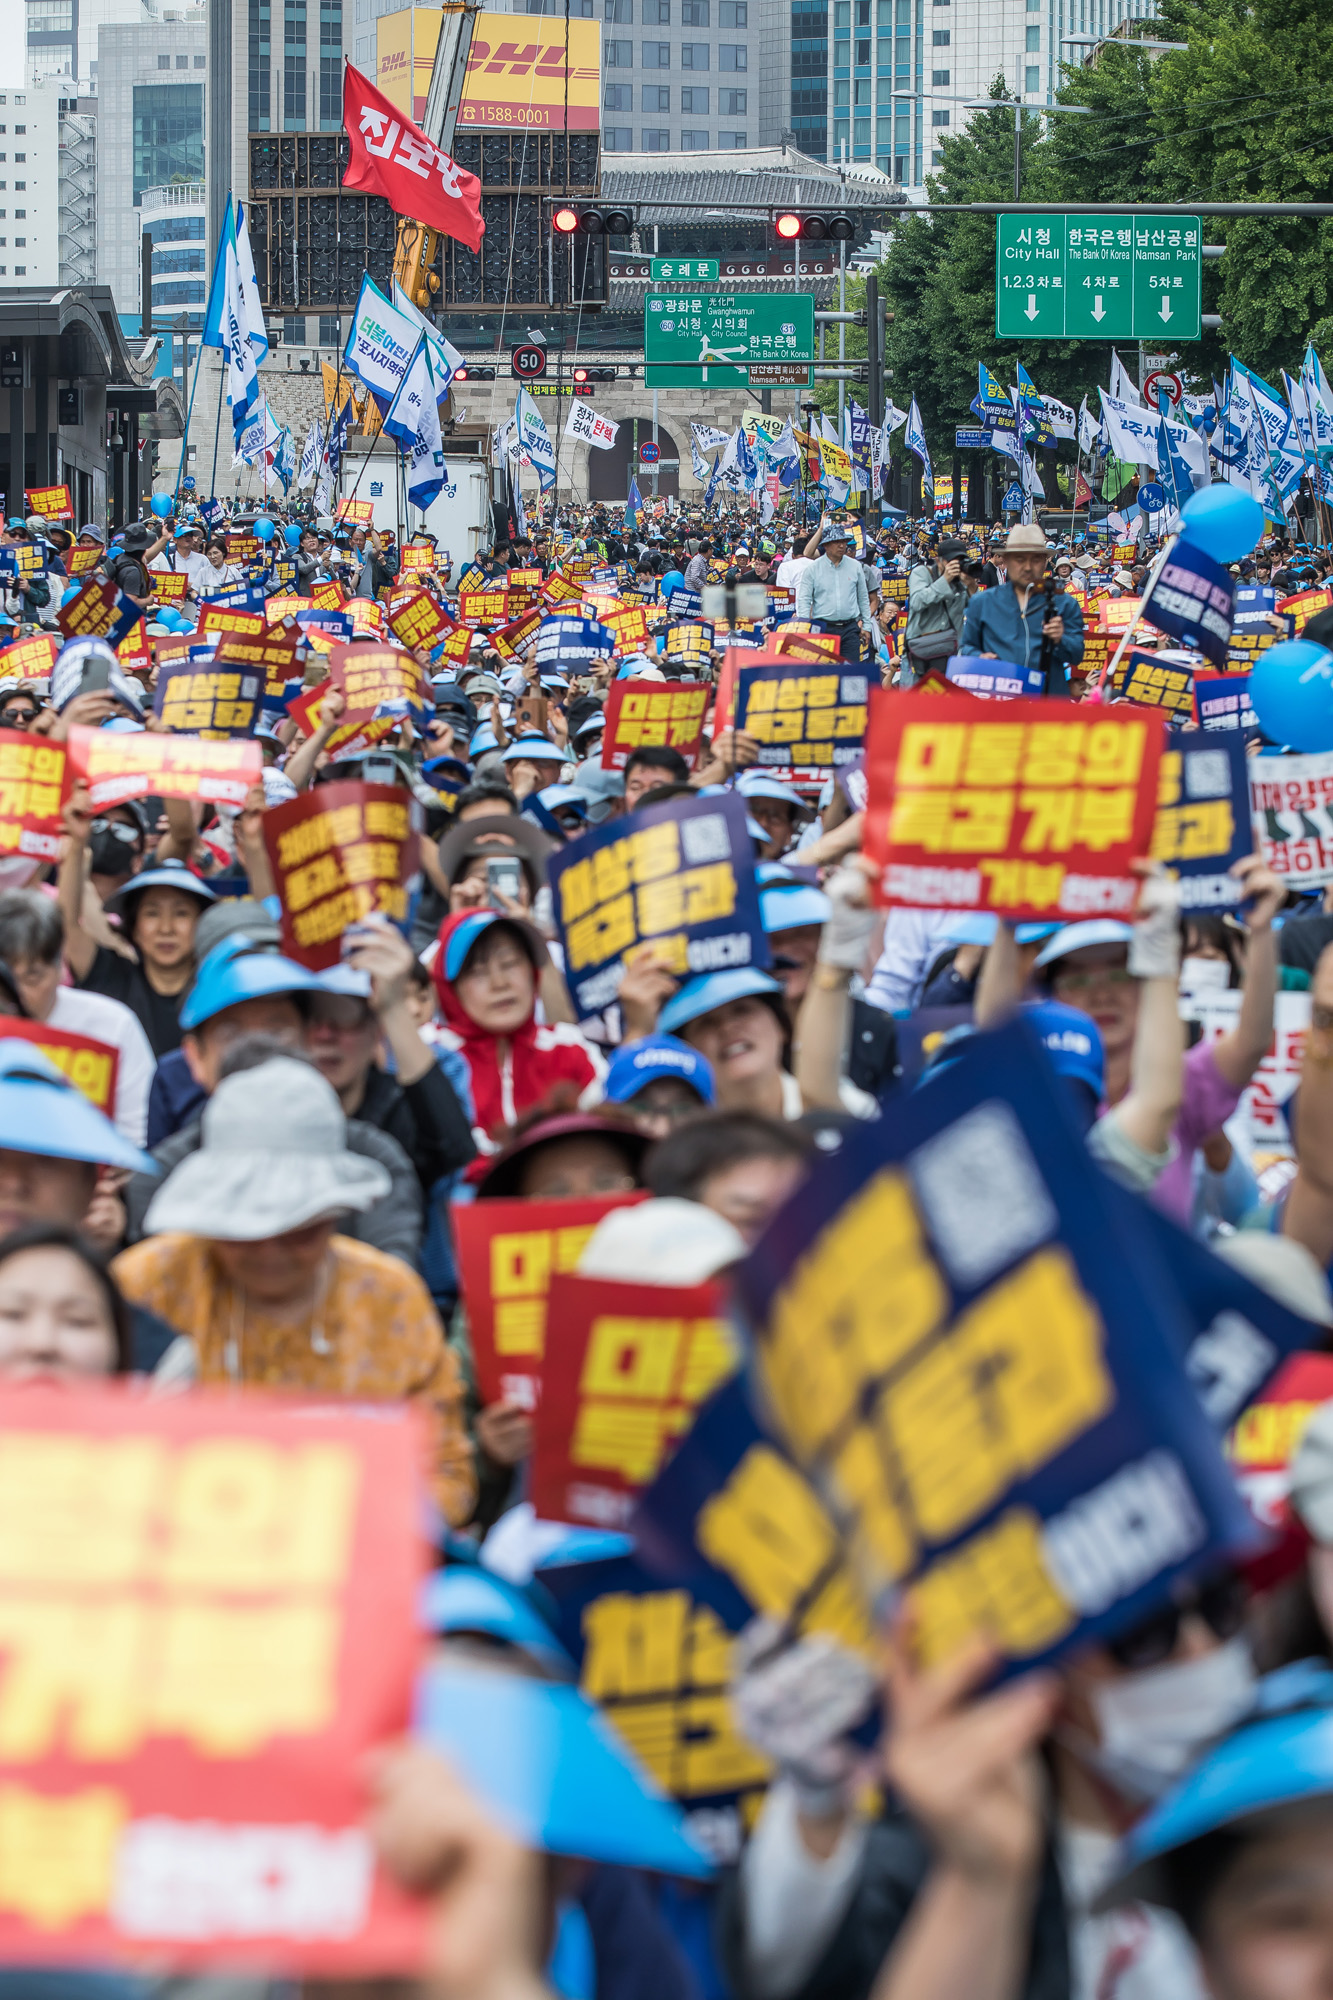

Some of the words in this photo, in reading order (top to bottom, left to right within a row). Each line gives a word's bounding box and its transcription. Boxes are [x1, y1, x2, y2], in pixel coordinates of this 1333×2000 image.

[381, 51, 406, 73] DHL
[479, 106, 549, 124] 1588-0001
[1016, 227, 1051, 245] 시청
[1068, 228, 1132, 247] 한국은행
[1135, 229, 1197, 247] 남산공원
[1005, 247, 1032, 262] City
[1035, 248, 1060, 260] Hall
[1069, 249, 1081, 259] The
[1083, 249, 1099, 260] Bank
[1101, 249, 1109, 260] Of
[1110, 249, 1130, 260] Korea
[1135, 250, 1170, 260] Namsan
[1176, 250, 1196, 261] Park
[660, 262, 710, 277] 숭례문
[651, 302, 662, 310] 50
[665, 299, 702, 313] 광화문
[708, 297, 735, 306] 光化門
[707, 307, 755, 317] Gwanghwamun
[662, 321, 673, 330] 60
[678, 317, 701, 330] 시청
[711, 317, 748, 330] 시의회
[783, 324, 793, 333] 31
[359, 315, 411, 365] 더불어민
[677, 330, 690, 338] City
[711, 330, 724, 338] City
[749, 335, 797, 348] 한국은행
[520, 354, 538, 368] 50
[749, 350, 761, 358] The
[763, 350, 779, 358] Bank
[780, 350, 789, 358] Of
[790, 350, 809, 358] Korea
[1147, 358, 1163, 367] 1.5t
[750, 376, 778, 384] Namsan
[779, 376, 795, 384] Park
[67, 394, 74, 402] 2
[575, 386, 592, 395] 단속
[577, 405, 595, 423] 정치
[593, 419, 614, 442] 탄핵
[524, 427, 553, 456] 을지역
[443, 483, 457, 498] 영
[1159, 562, 1214, 602] 대통령
[465, 594, 505, 607] 대통령의
[486, 604, 504, 615] 거부
[952, 673, 993, 690] 대통령
[995, 676, 1023, 695] 말고
[1131, 662, 1189, 691] 채상병
[746, 675, 839, 713] 채상병
[1125, 682, 1163, 705] 특검
[619, 688, 707, 720] 대통령의
[1201, 693, 1239, 717] 대통령
[744, 710, 804, 743] 특검
[805, 705, 869, 740] 통과
[615, 720, 668, 748] 특검
[757, 748, 791, 766] 민의
[895, 719, 1147, 787] 대통령의
[887, 788, 1016, 854] 특검
[1018, 787, 1137, 853] 거부
[558, 819, 681, 926] 채상병
[566, 892, 637, 971] 특검
[636, 860, 738, 937] 통과
